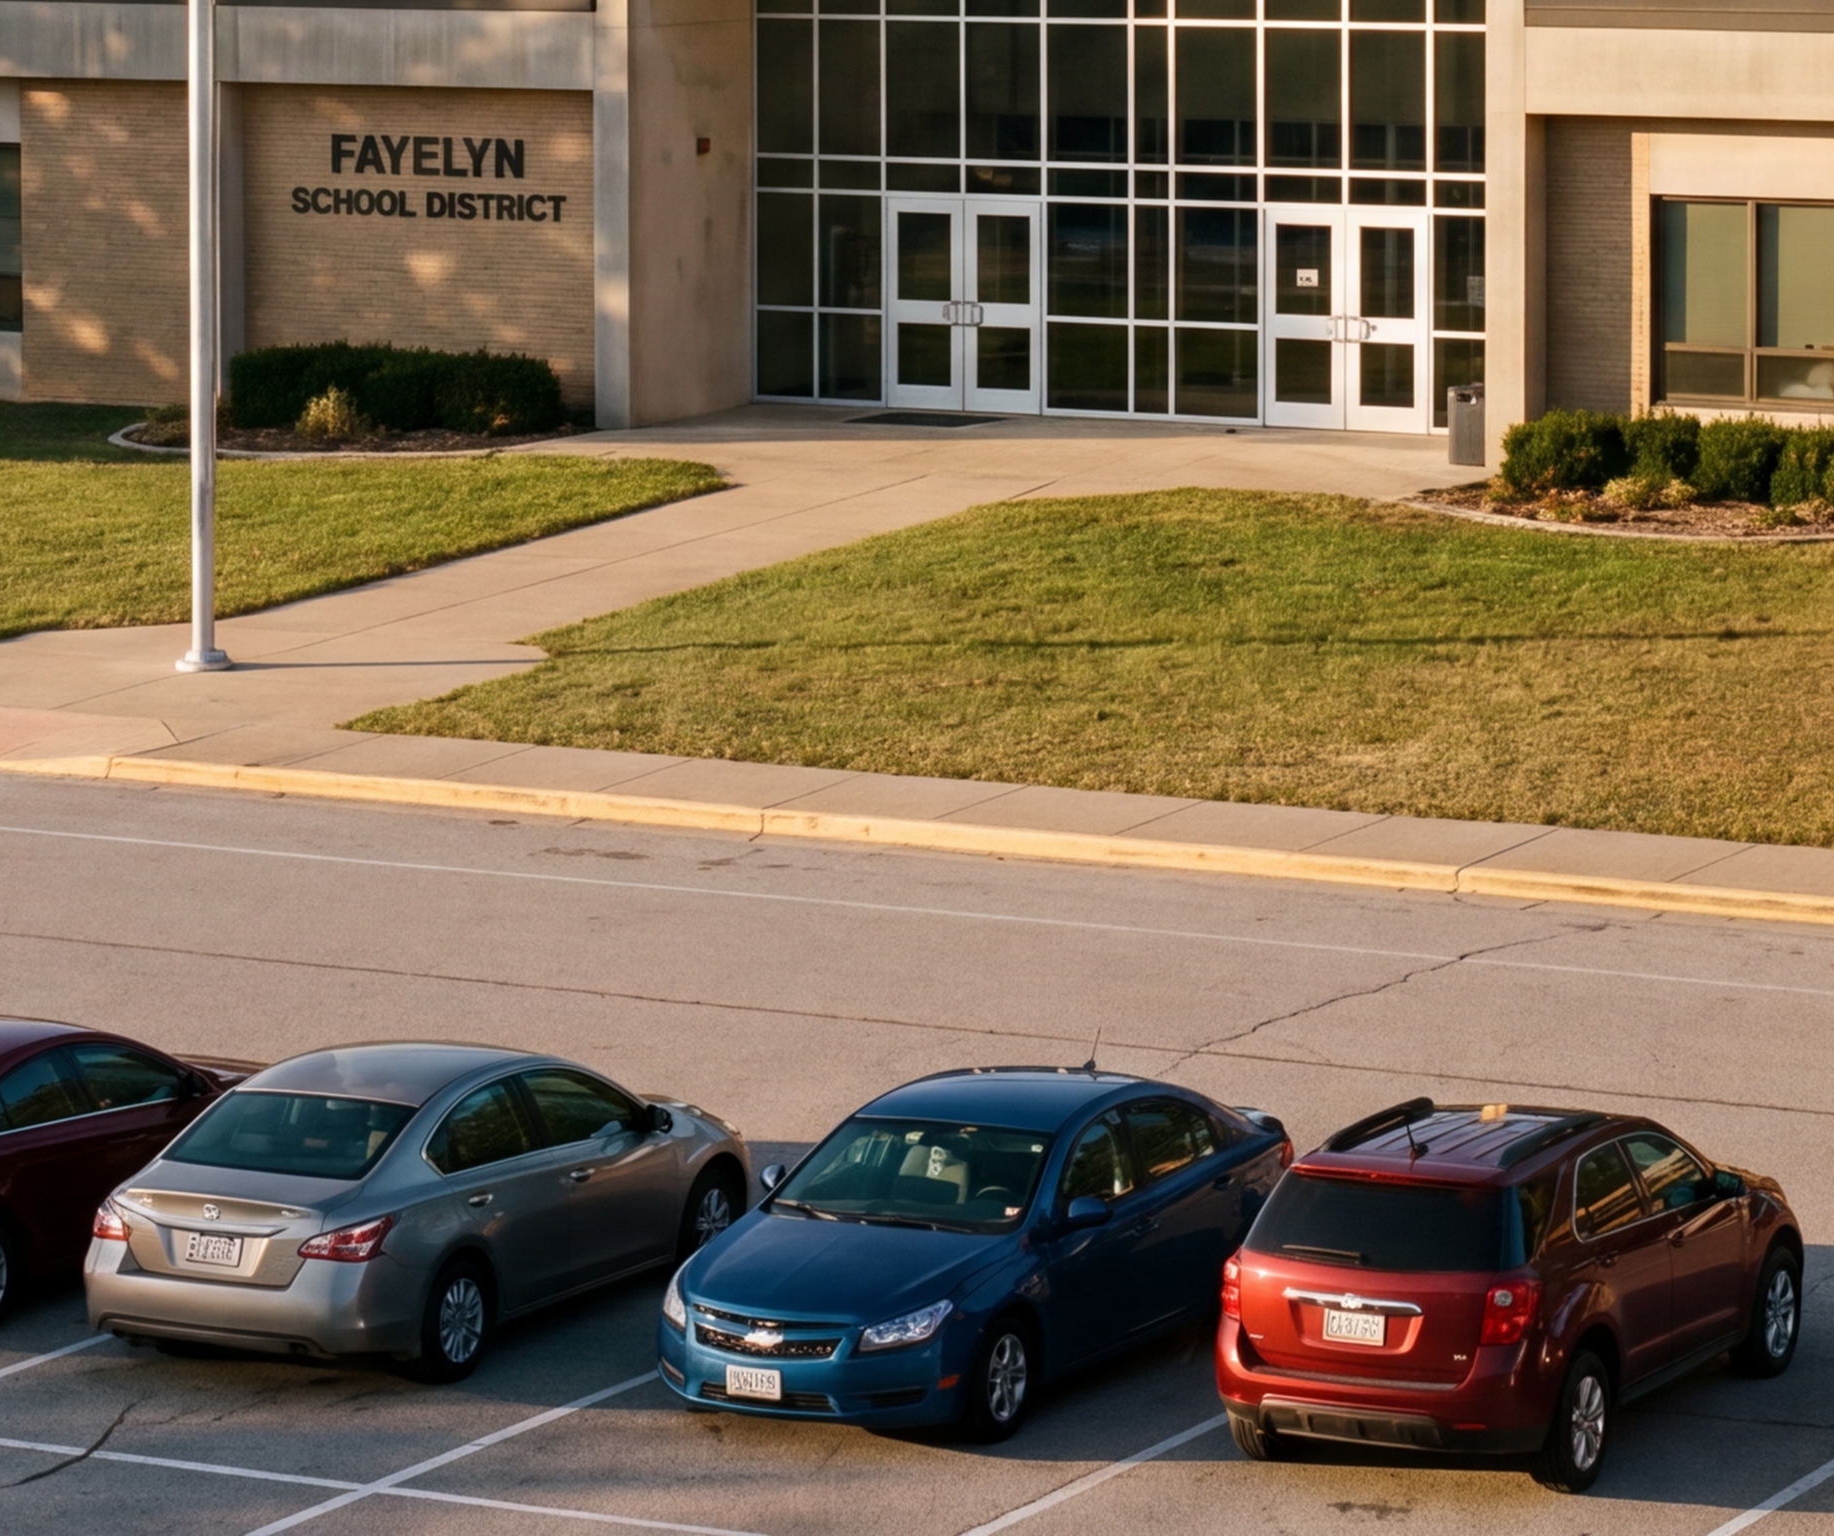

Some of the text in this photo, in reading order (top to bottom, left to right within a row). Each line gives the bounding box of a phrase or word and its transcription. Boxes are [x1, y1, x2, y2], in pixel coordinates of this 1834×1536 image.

[330, 133, 525, 179] FAYELYN
[291, 186, 567, 222] SCHOOL DISTRICT
